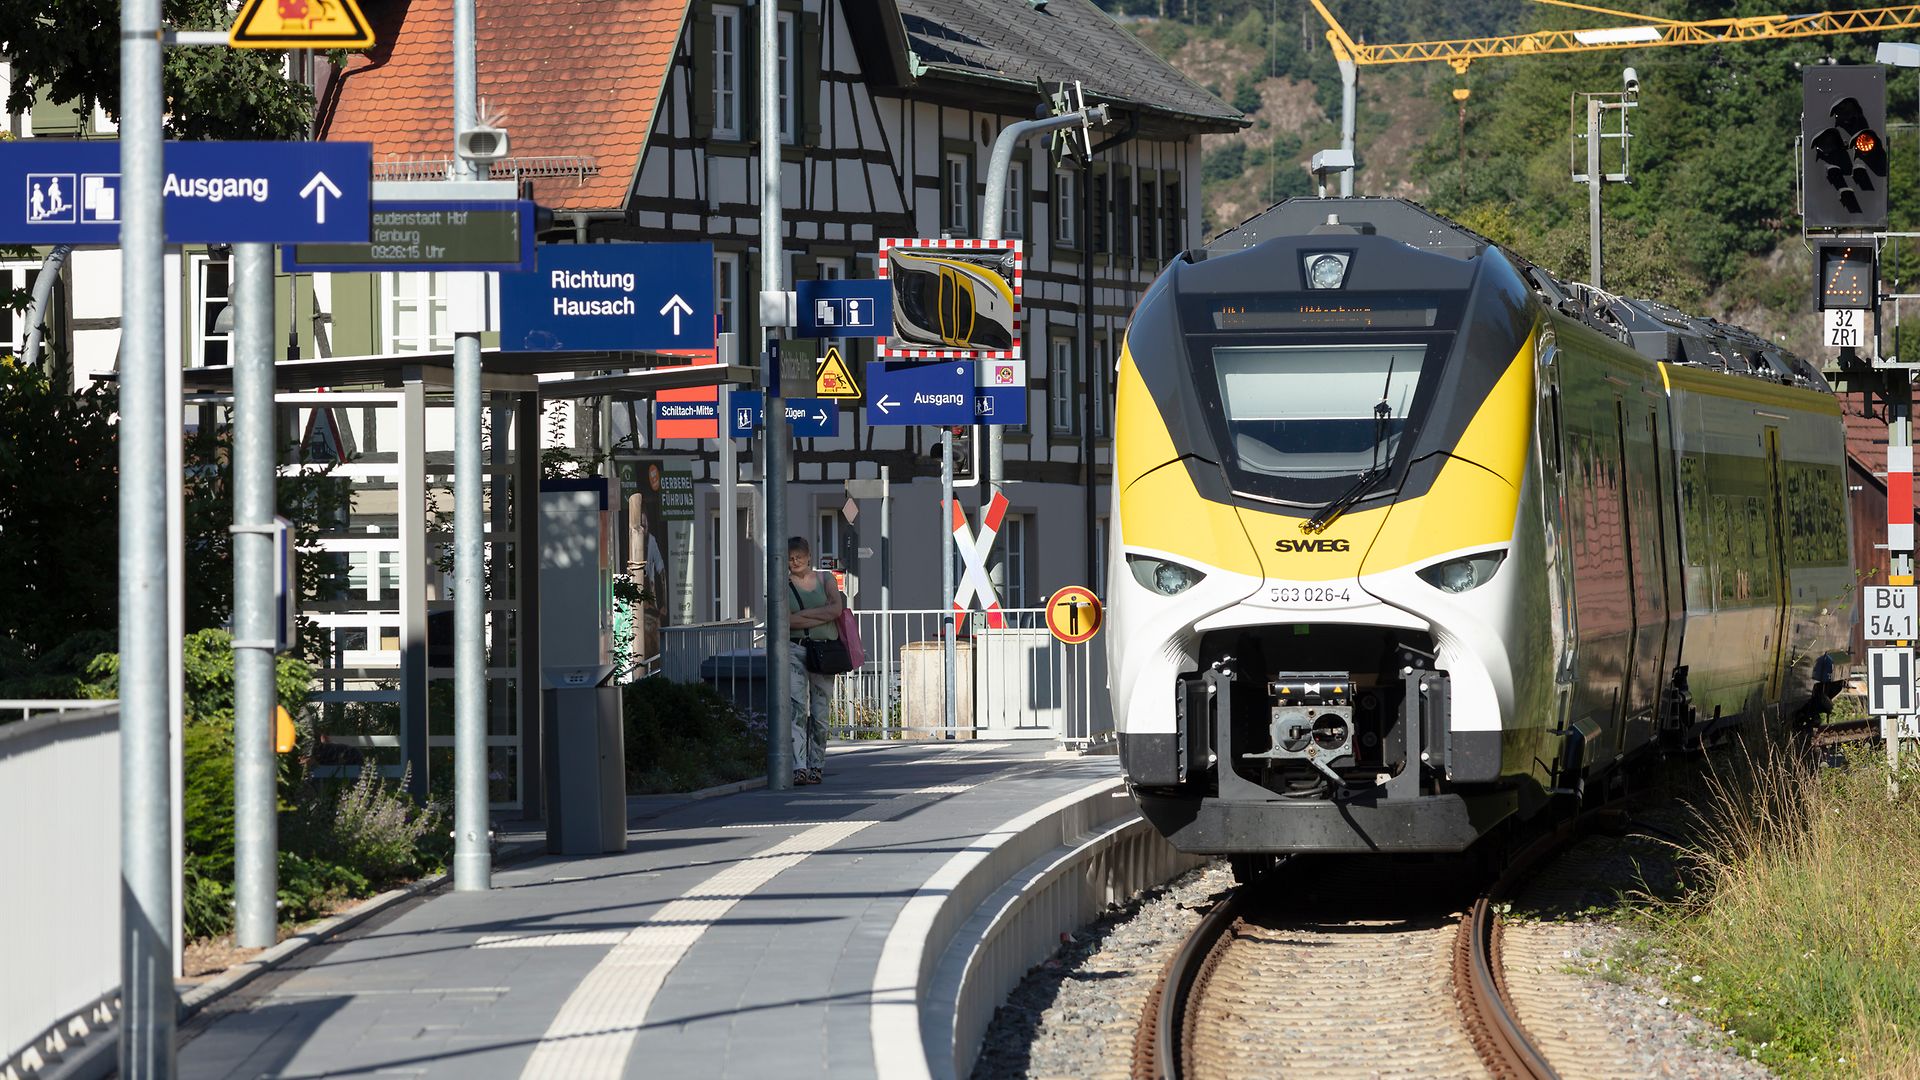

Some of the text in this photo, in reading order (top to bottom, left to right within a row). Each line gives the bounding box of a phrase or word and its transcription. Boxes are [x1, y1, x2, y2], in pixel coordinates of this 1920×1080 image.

[163, 173, 269, 202] Ausgang
[372, 211, 518, 225] eudenstadt Hbf 1
[374, 228, 518, 244] fenburg 1
[371, 245, 446, 258] 09:26:15 Uhr
[551, 270, 635, 292] Richtung
[553, 296, 635, 316] Hausach
[1835, 309, 1853, 327] 32
[1831, 328, 1857, 346] ZR1
[913, 392, 964, 405] Ausgang
[661, 405, 714, 417] Schiltach-Mitte
[785, 407, 806, 420] Zügen
[661, 490, 694, 506] FÜHRUNG
[1275, 539, 1350, 552] SWEG
[1271, 587, 1350, 602] 563 026-4
[1876, 588, 1905, 609] Bü
[1871, 615, 1911, 637] 54,1
[1873, 652, 1910, 709] H
